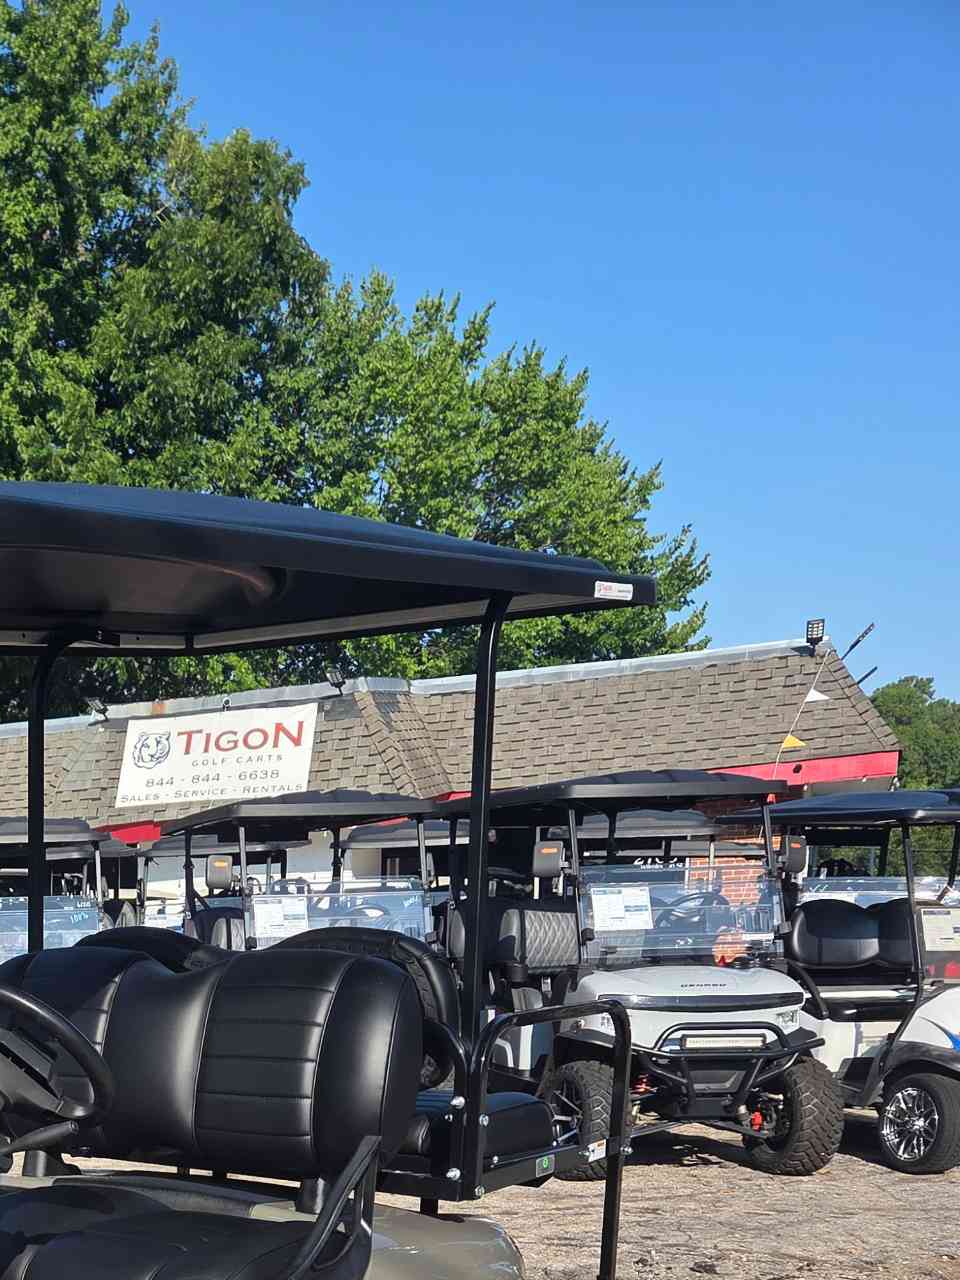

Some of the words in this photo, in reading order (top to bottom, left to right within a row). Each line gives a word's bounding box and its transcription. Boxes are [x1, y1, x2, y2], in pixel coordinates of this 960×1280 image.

[177, 720, 304, 755] TIGON
[192, 757, 229, 767] GOLF
[236, 754, 283, 764] CARTS
[146, 777, 174, 787] 844
[191, 773, 221, 784] 844
[238, 769, 280, 781] 6638
[121, 792, 160, 802] SALES
[174, 787, 227, 798] SERVICE
[242, 783, 303, 794] RENTALS
